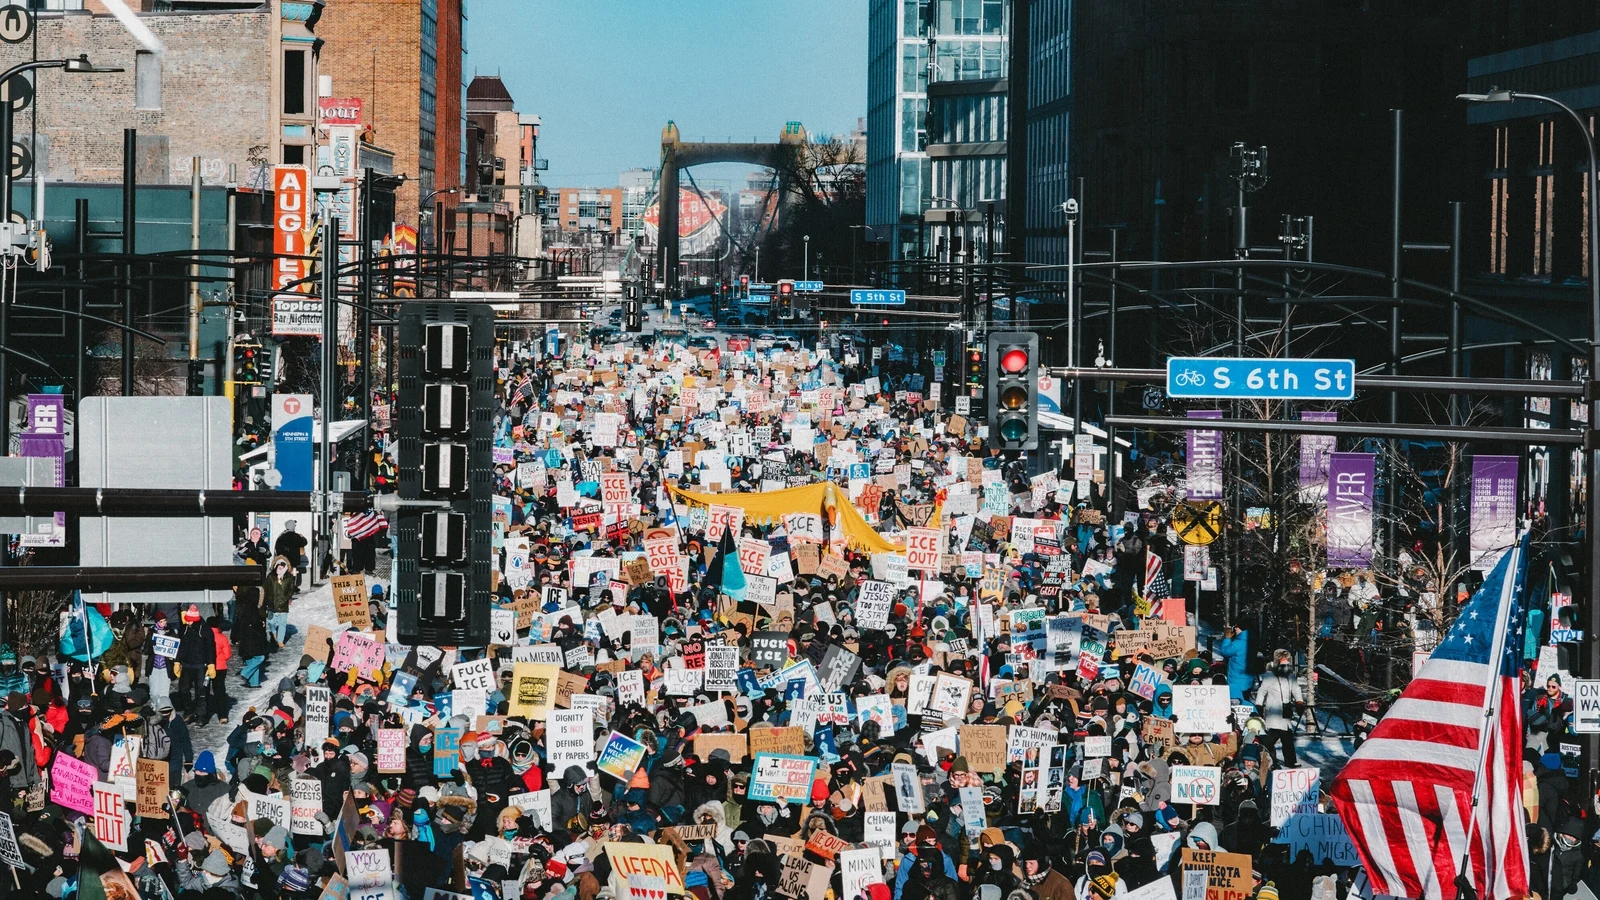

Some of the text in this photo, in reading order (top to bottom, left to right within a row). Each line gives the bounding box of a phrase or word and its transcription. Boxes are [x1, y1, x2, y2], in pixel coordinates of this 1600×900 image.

[855, 293, 901, 301] S 5th St
[1213, 367, 1347, 390] S 6th St
[605, 479, 625, 489] ICE
[605, 491, 628, 501] OUT!
[585, 505, 599, 513] ICE
[914, 505, 930, 520] ICE
[573, 515, 600, 525] RESIST
[711, 513, 737, 525] ICE
[788, 517, 814, 534] ICE
[910, 536, 937, 549] ICE
[648, 545, 674, 556] ICE
[741, 550, 765, 561] ICE
[1191, 550, 1201, 558] NO
[651, 556, 678, 567] OUT!
[908, 550, 938, 567] OUT!
[770, 561, 785, 571] OUT
[986, 569, 1005, 580] ICE
[864, 582, 889, 594] I LOVE
[984, 581, 1005, 592] OUT
[1040, 586, 1060, 595] GREAT
[339, 594, 362, 602] SHIT!
[548, 588, 562, 604] ICE
[864, 592, 889, 602] JESUS
[873, 603, 889, 612] MUCH
[866, 611, 886, 619] STAY
[1014, 609, 1046, 622] PROUD
[1014, 621, 1042, 632] TO BE
[1168, 627, 1183, 637] ICE
[1082, 625, 1098, 640] BE
[1116, 632, 1150, 640] Immigrants
[683, 643, 701, 654] NO
[753, 639, 787, 648] FUCK
[950, 639, 965, 651] ICE
[1014, 642, 1034, 653] ICE
[756, 651, 782, 661] ICE
[1006, 653, 1022, 663] ICE
[458, 663, 489, 677] FUCK
[1083, 659, 1095, 671] ICE
[619, 672, 637, 682] ICE
[667, 670, 701, 684] FUCK
[709, 669, 736, 679] MURDER
[1134, 664, 1161, 687] MN
[463, 676, 487, 690] ICE
[620, 683, 639, 692] OUT
[309, 691, 328, 702] MN
[1185, 688, 1216, 697] STOP
[307, 704, 327, 714] nice
[1186, 709, 1203, 719] ICE
[307, 714, 329, 723] melts
[556, 714, 584, 722] DIGNITY
[797, 712, 810, 721] MY
[1144, 717, 1172, 728] PROTEST
[1193, 721, 1214, 730] NOW
[786, 727, 800, 735] MY
[964, 729, 992, 738] WHERE
[1015, 729, 1057, 742] NO HUMAN
[436, 733, 459, 750] ICE
[556, 740, 584, 748] DEFINED
[752, 735, 803, 745] IMMIGRANT
[964, 740, 997, 749] IS YOUR
[1143, 735, 1170, 746] CRIME
[610, 741, 639, 760] ALL ARE
[379, 754, 402, 762] EXPECT
[602, 755, 625, 769] HERE
[434, 754, 459, 774] OUT
[771, 759, 811, 770] I FIGHT
[52, 768, 88, 786] INVADING
[144, 773, 165, 782] LOVE
[1175, 768, 1214, 778] MINNESOTA
[1276, 770, 1317, 791] STOP
[295, 782, 320, 792] GOING
[1177, 783, 1214, 798] NICE
[145, 797, 157, 806] ALL
[1273, 791, 1317, 804] PRETENDING
[95, 790, 122, 818] ICE
[256, 800, 283, 816] BRING
[1273, 804, 1318, 818] YOUR RACISM
[293, 821, 314, 830] MORE
[867, 815, 895, 825] CHINGA
[96, 818, 123, 845] OUT
[679, 825, 712, 839] OUT NOW
[783, 844, 802, 853] OUT
[824, 837, 845, 851] OUT
[1192, 852, 1216, 863] KEEP
[785, 857, 812, 874] LEAVE
[848, 858, 875, 872] MINN
[789, 871, 800, 880] US
[779, 878, 806, 896] ALONE
